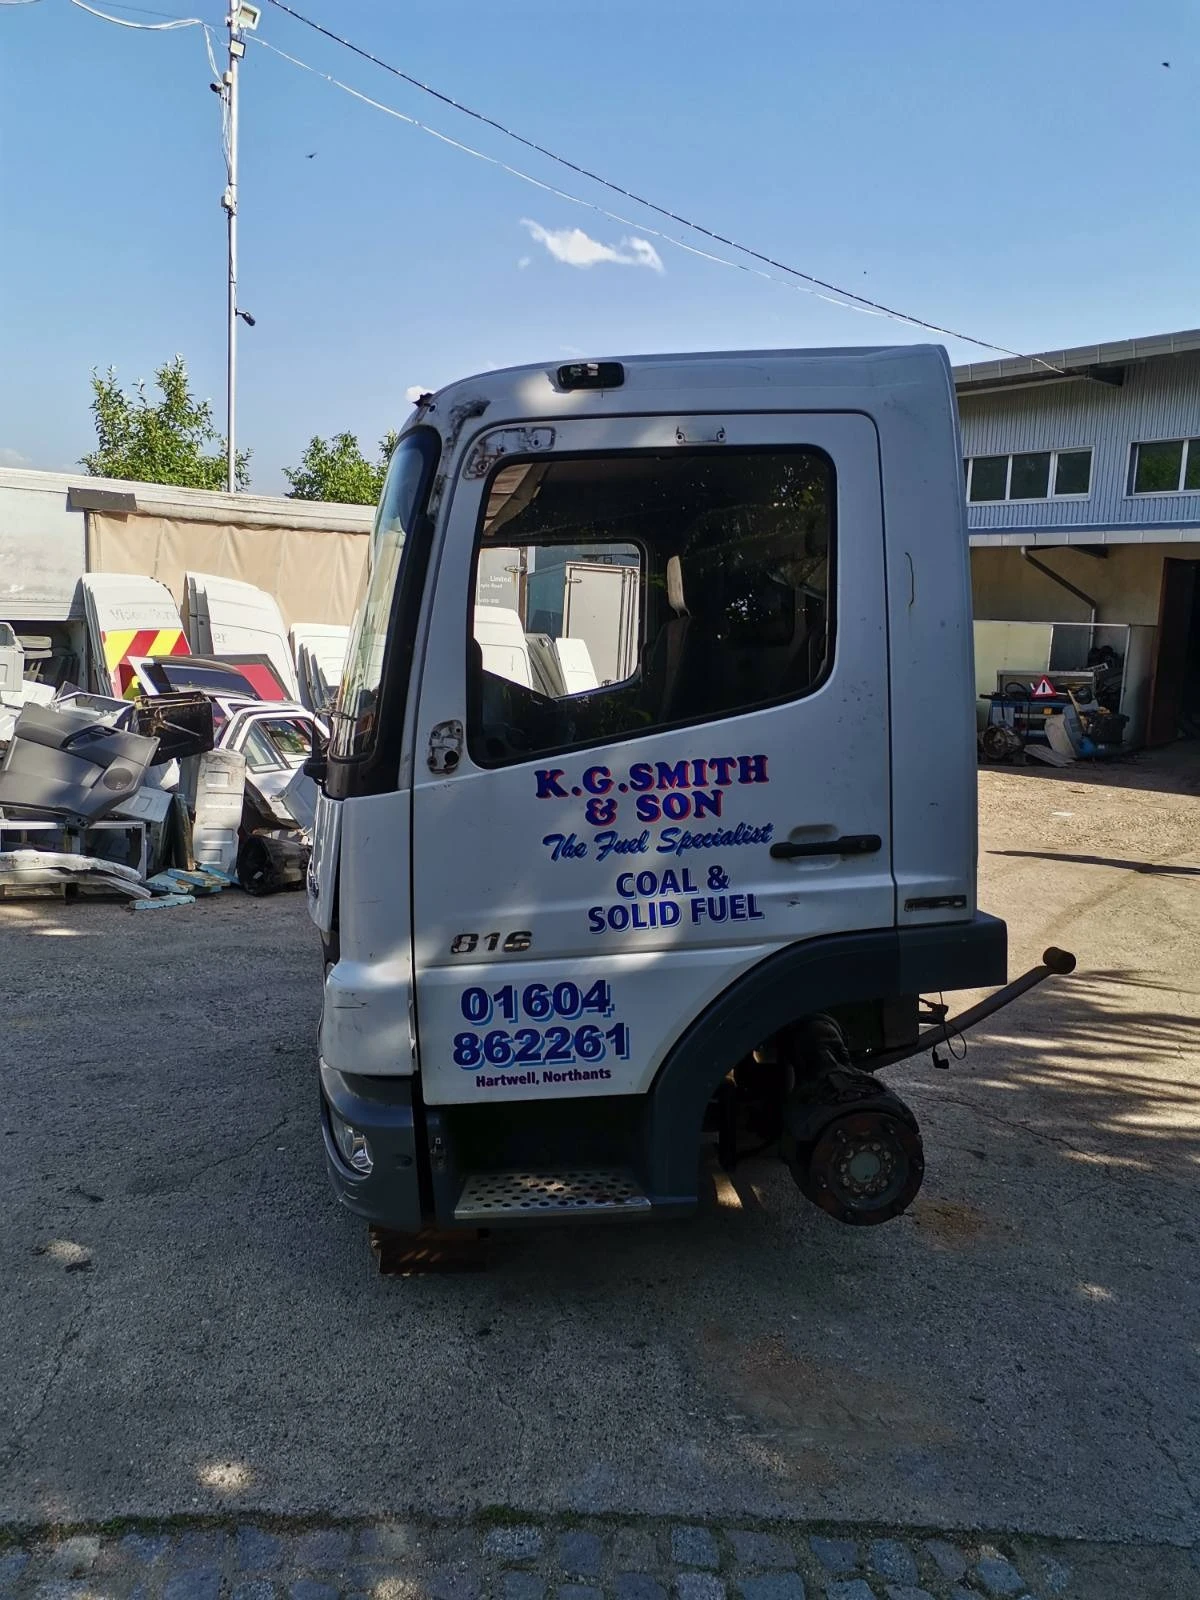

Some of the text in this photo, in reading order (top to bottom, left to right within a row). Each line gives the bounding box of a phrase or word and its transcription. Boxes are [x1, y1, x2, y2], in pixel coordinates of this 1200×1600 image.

[534, 754, 769, 799] K.G.SMITH
[585, 789, 724, 826] & SON
[542, 821, 775, 862] The Fuel Specialist
[616, 864, 732, 900] COAL &
[587, 892, 766, 934] SOLID FUEL
[460, 979, 615, 1026] 01604
[452, 1022, 630, 1071] 862261
[475, 1067, 612, 1088] Hartwell, Northants
